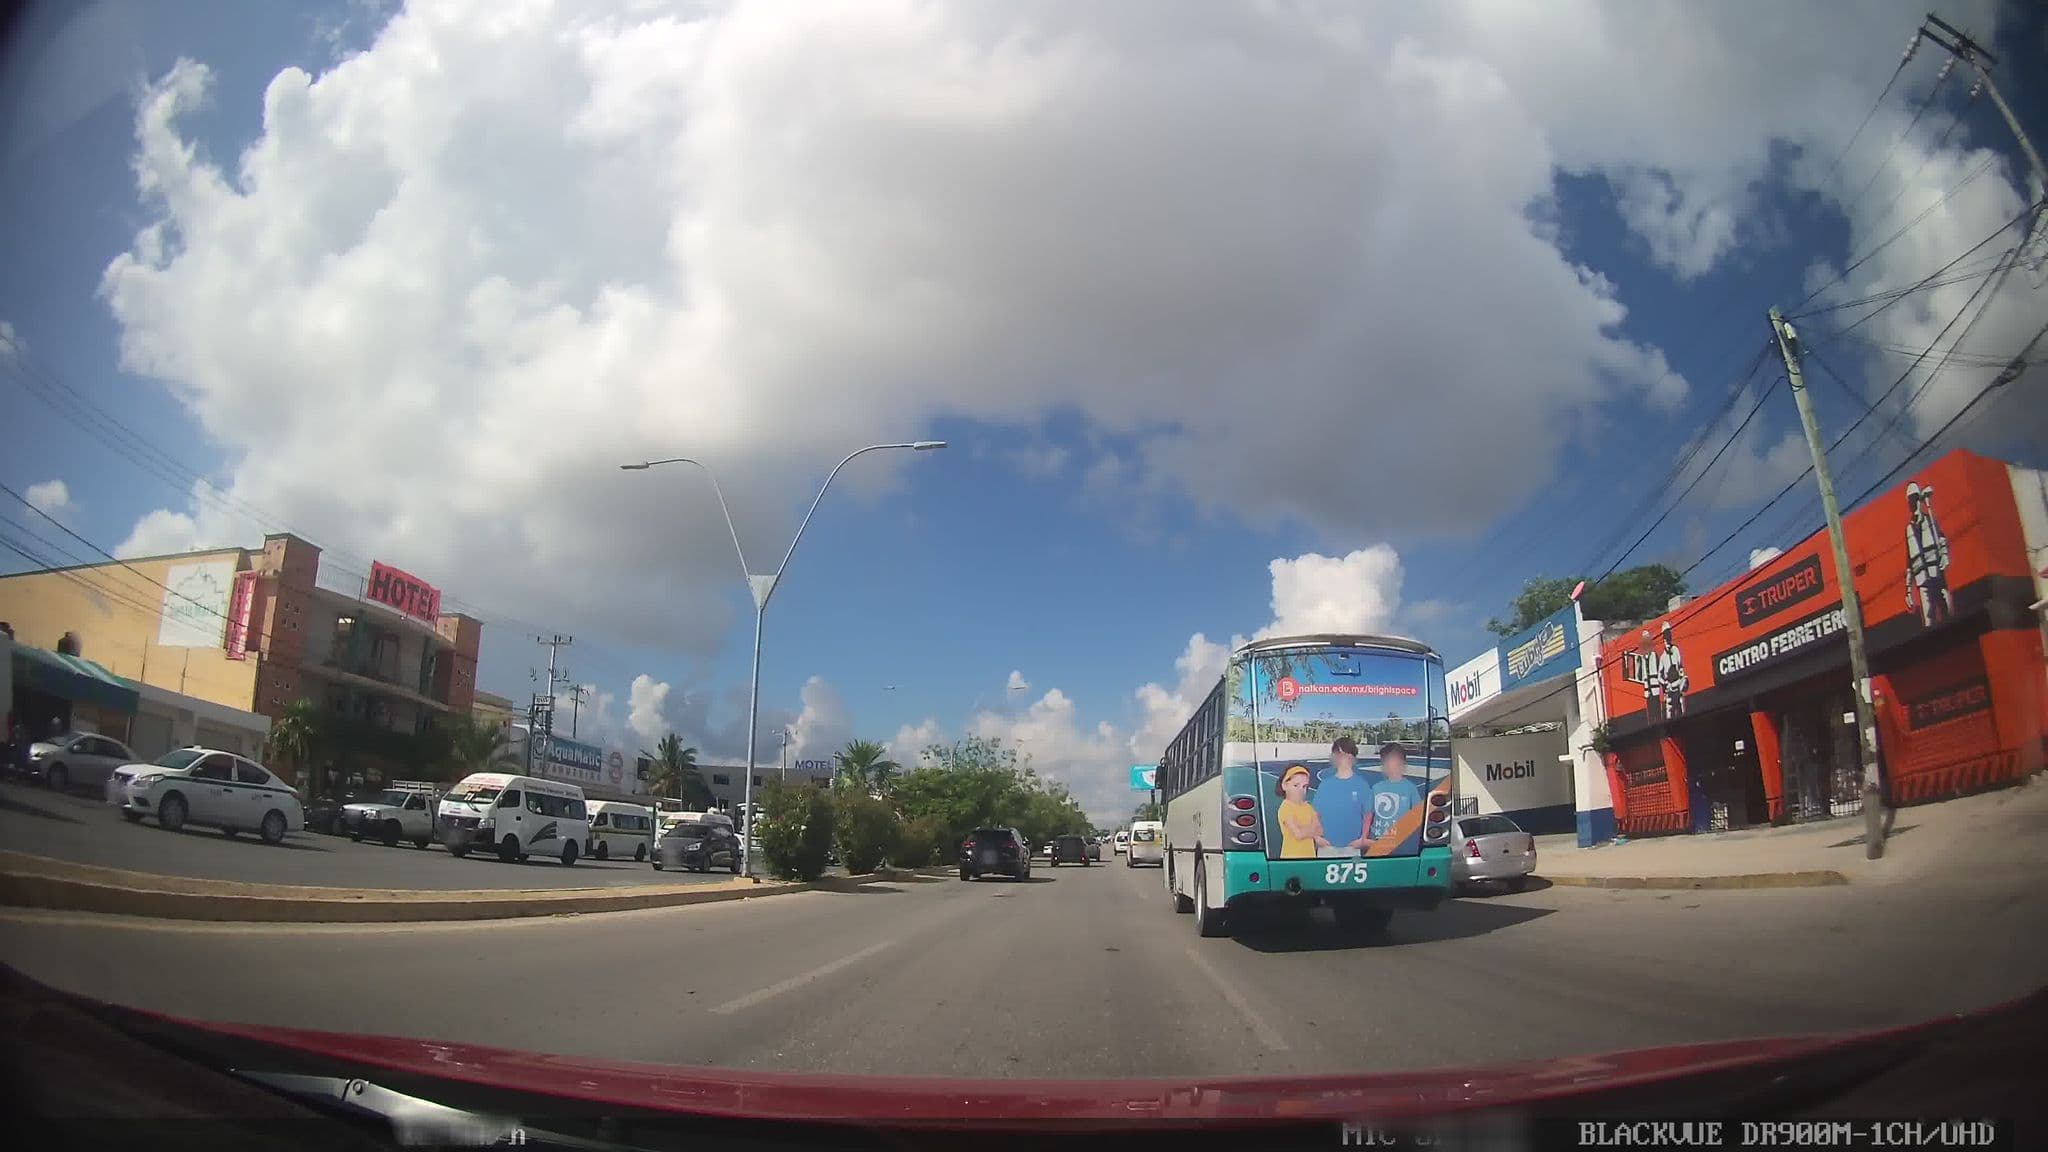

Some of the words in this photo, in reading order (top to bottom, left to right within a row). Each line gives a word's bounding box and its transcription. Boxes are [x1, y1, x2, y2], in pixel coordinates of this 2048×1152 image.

[372, 568, 436, 621] HOTEL
[1757, 566, 1817, 609] TRUPER
[1719, 641, 1769, 676] CENTRO
[1450, 670, 1482, 708] Mobil
[795, 759, 834, 769] MOTEL
[1486, 760, 1535, 781] Mobil
[1325, 863, 1367, 883] 875
